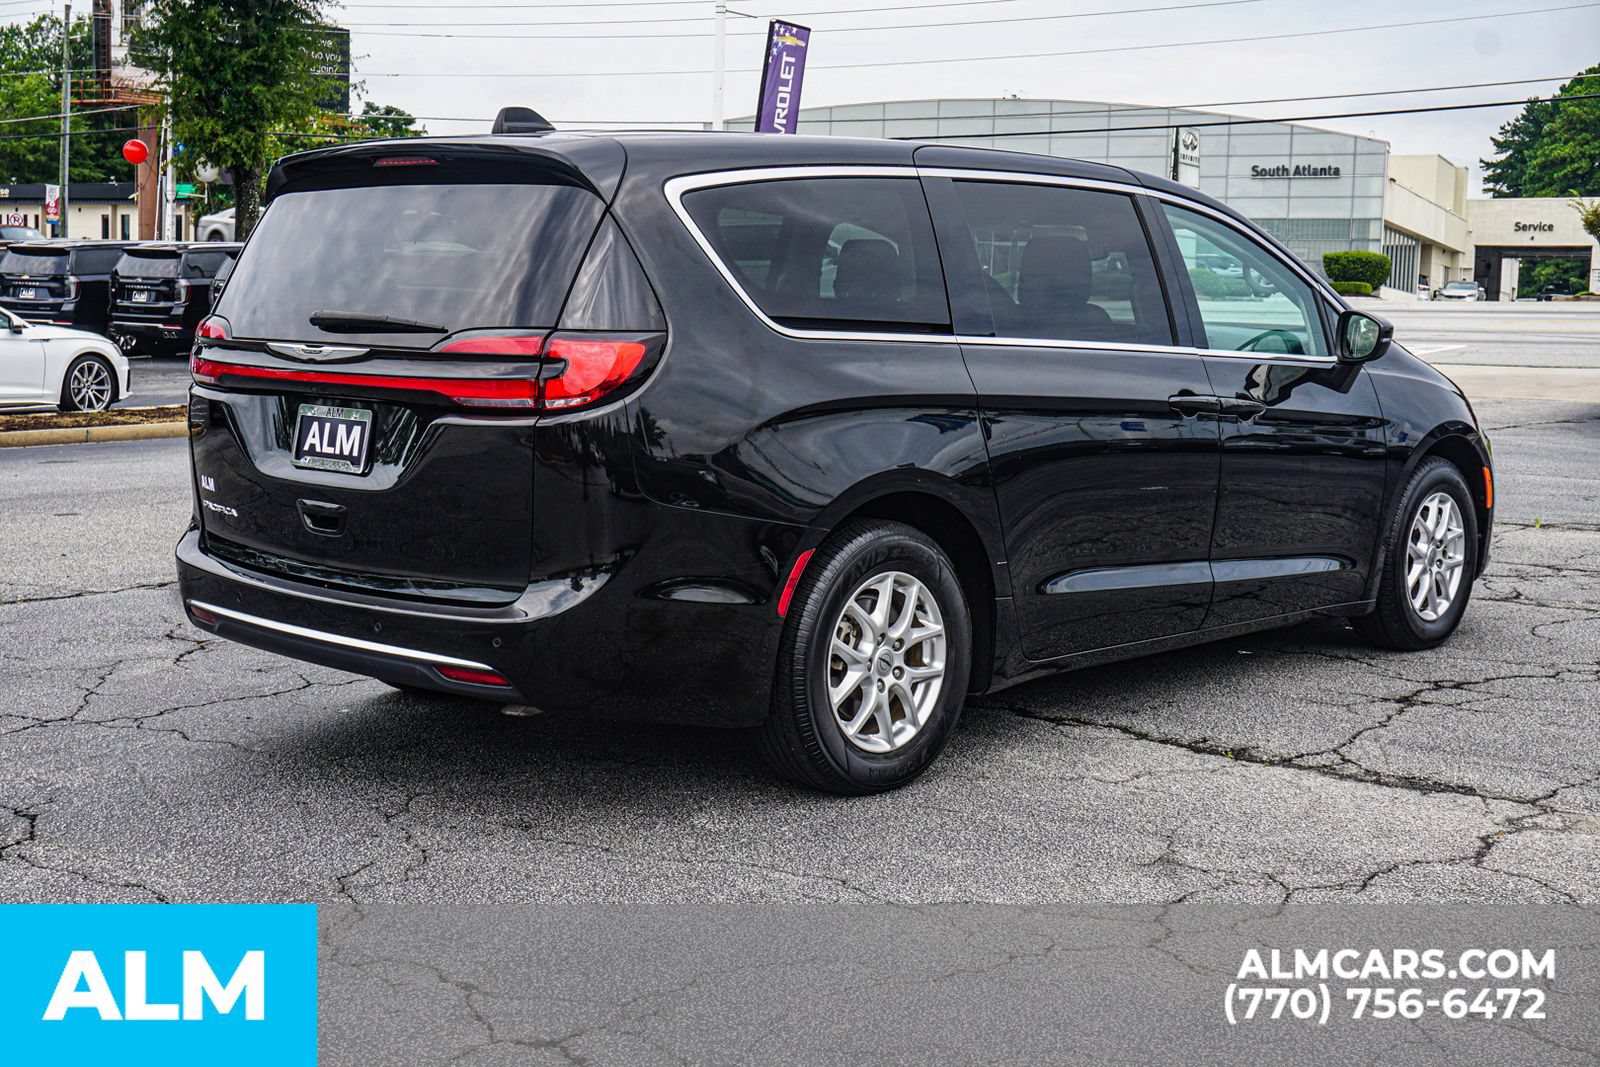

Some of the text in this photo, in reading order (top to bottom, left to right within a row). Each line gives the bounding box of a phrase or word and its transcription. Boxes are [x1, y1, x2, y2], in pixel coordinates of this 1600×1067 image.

[1251, 164, 1340, 177] South Atlanta
[1514, 221, 1554, 232] Service
[326, 407, 344, 418] ALM
[303, 421, 361, 457] ALM
[201, 474, 216, 492] ALM
